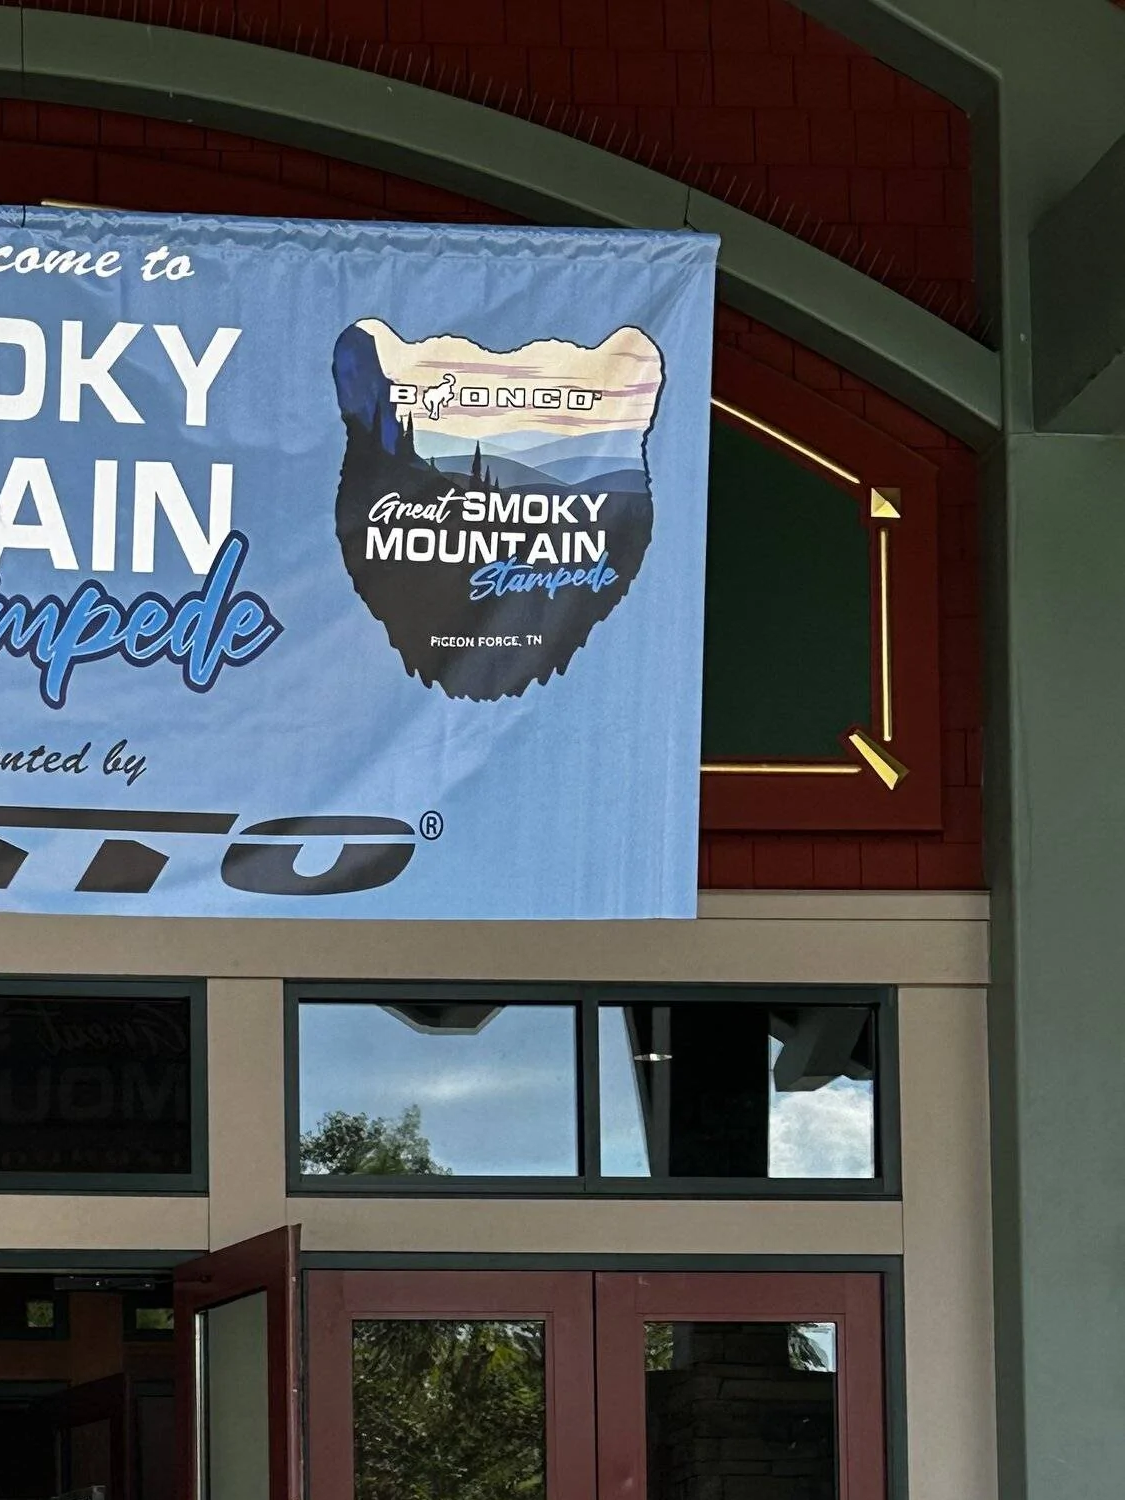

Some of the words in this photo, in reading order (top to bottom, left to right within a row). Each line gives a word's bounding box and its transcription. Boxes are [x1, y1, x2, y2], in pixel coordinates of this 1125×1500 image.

[141, 243, 195, 281] to
[368, 488, 468, 524] Great
[462, 492, 608, 524] SMOKY
[365, 527, 606, 564] MOUNTAIN
[469, 551, 619, 600] Stampede
[430, 635, 475, 647] PIGEON
[478, 635, 522, 647] FORGE,
[526, 634, 543, 646] TN
[104, 740, 148, 785] by
